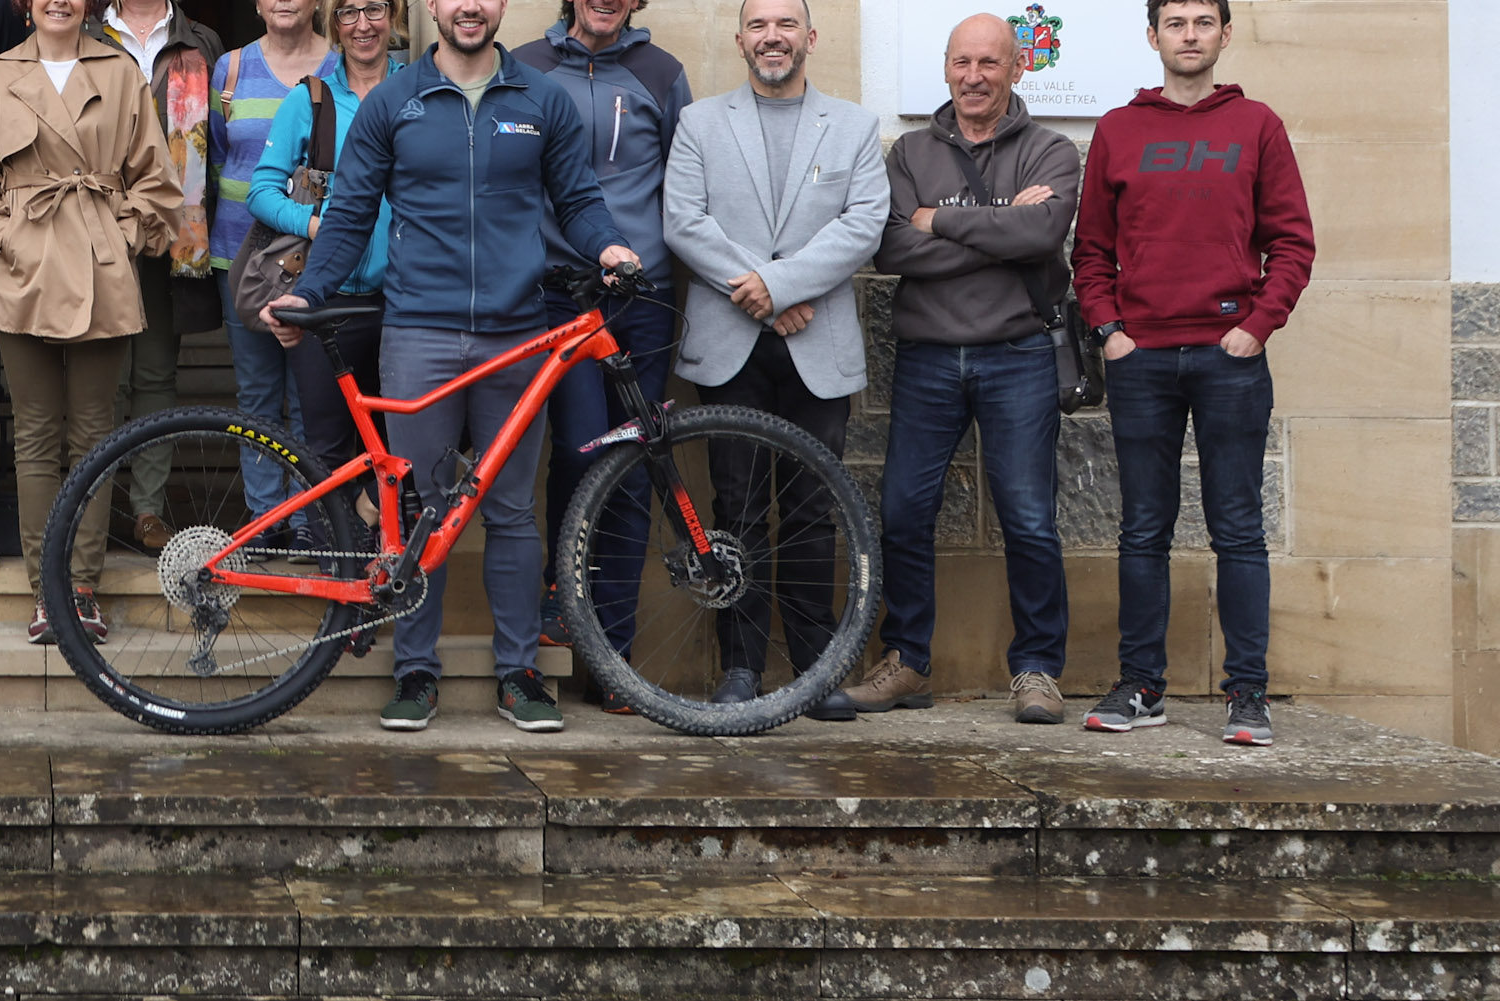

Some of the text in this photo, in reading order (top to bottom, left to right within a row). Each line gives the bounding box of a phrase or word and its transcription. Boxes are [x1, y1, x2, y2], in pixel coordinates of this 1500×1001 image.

[1021, 81, 1040, 91] DEL
[1044, 81, 1075, 91] VALLE
[1065, 94, 1097, 105] ETXEA
[1138, 140, 1243, 173] BH
[1168, 187, 1212, 200] TEAM
[226, 424, 300, 464] MAXXIS
[680, 501, 711, 555] ROCKSHOX
[575, 519, 589, 599] MAXXIS
